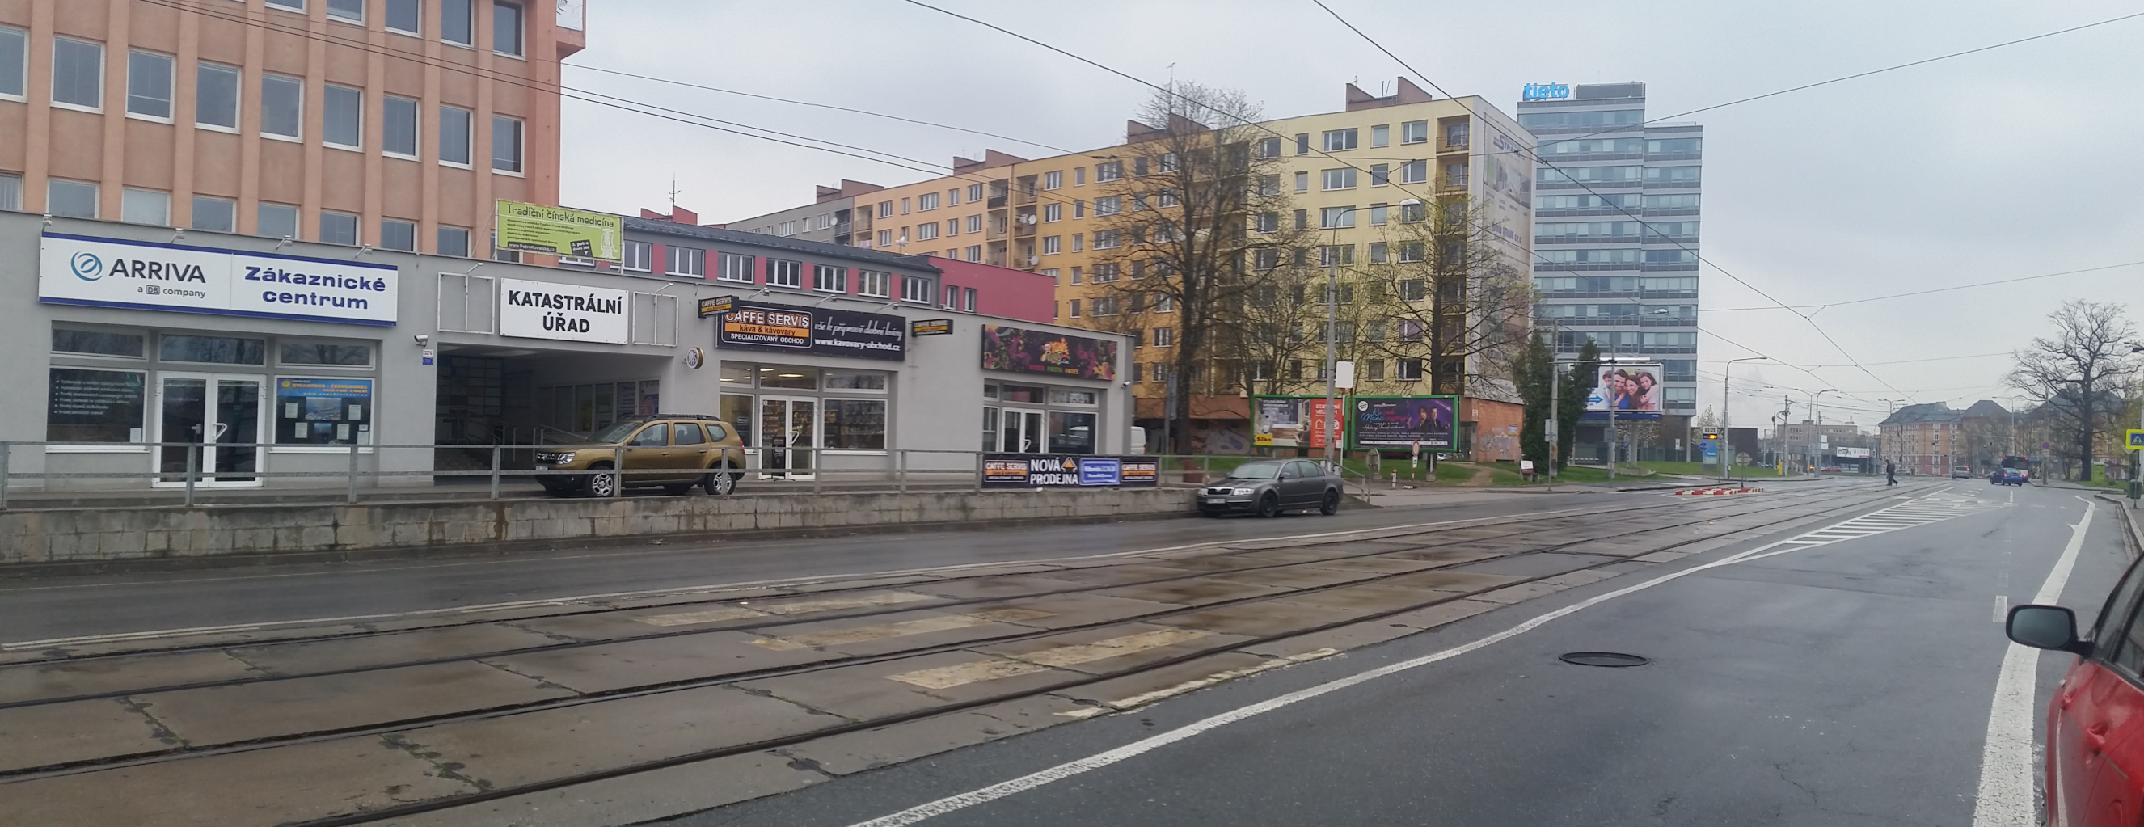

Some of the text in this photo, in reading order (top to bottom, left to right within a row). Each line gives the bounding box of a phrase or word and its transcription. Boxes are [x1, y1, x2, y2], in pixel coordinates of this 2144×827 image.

[1523, 82, 1569, 100] tieto
[546, 210, 575, 223] čínská
[108, 258, 206, 284] ARRIVA
[244, 265, 387, 293] Zákaznické
[162, 287, 206, 299] company
[262, 290, 369, 310] centrum
[508, 289, 623, 315] KATASTRÁLNÍ
[542, 312, 590, 333] ÚŘAD
[725, 309, 766, 324] CAFFE
[768, 312, 809, 327] SERVIS
[730, 332, 805, 345] SPECIALIZOVANÝ OBCHOD
[739, 325, 756, 333] káva
[764, 326, 796, 337] kávovary
[1030, 457, 1061, 472] NOVÁ
[1030, 473, 1079, 485] PRODEJNA
